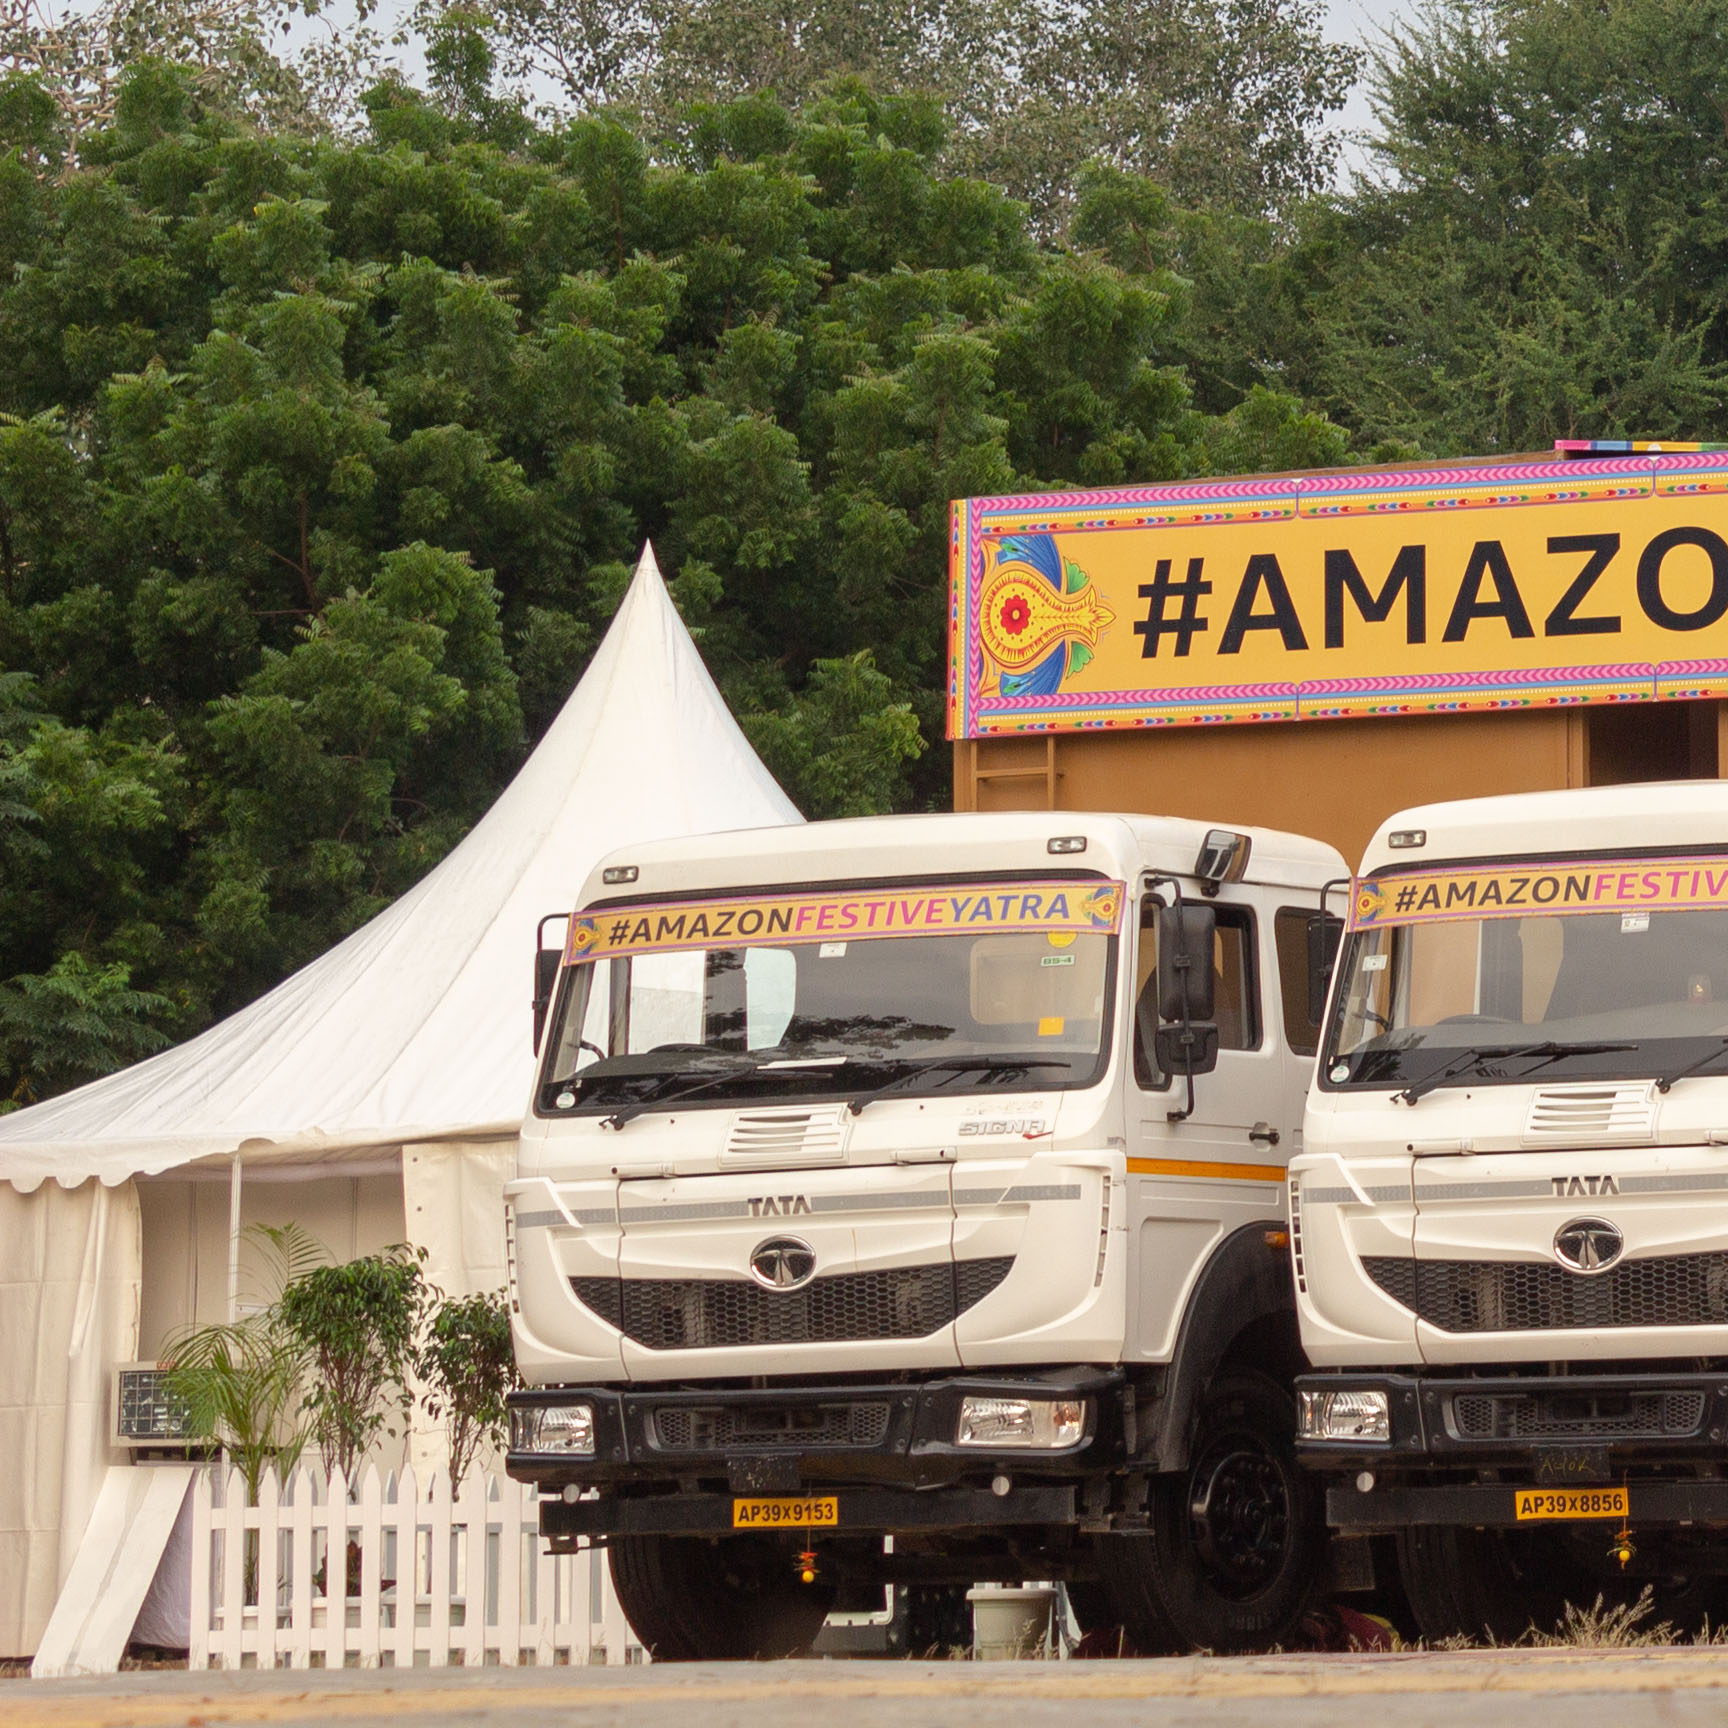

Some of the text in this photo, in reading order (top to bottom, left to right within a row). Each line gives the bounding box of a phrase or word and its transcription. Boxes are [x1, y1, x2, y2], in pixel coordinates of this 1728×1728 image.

[608, 893, 1069, 944] #AMAZONFESTIVEYATRA
[959, 1119, 1046, 1137] SIGNA
[1552, 1175, 1619, 1196] TATA
[748, 1194, 811, 1217] TATA
[738, 1503, 834, 1521] AP39X9153
[1521, 1494, 1623, 1514] AP39X8856
